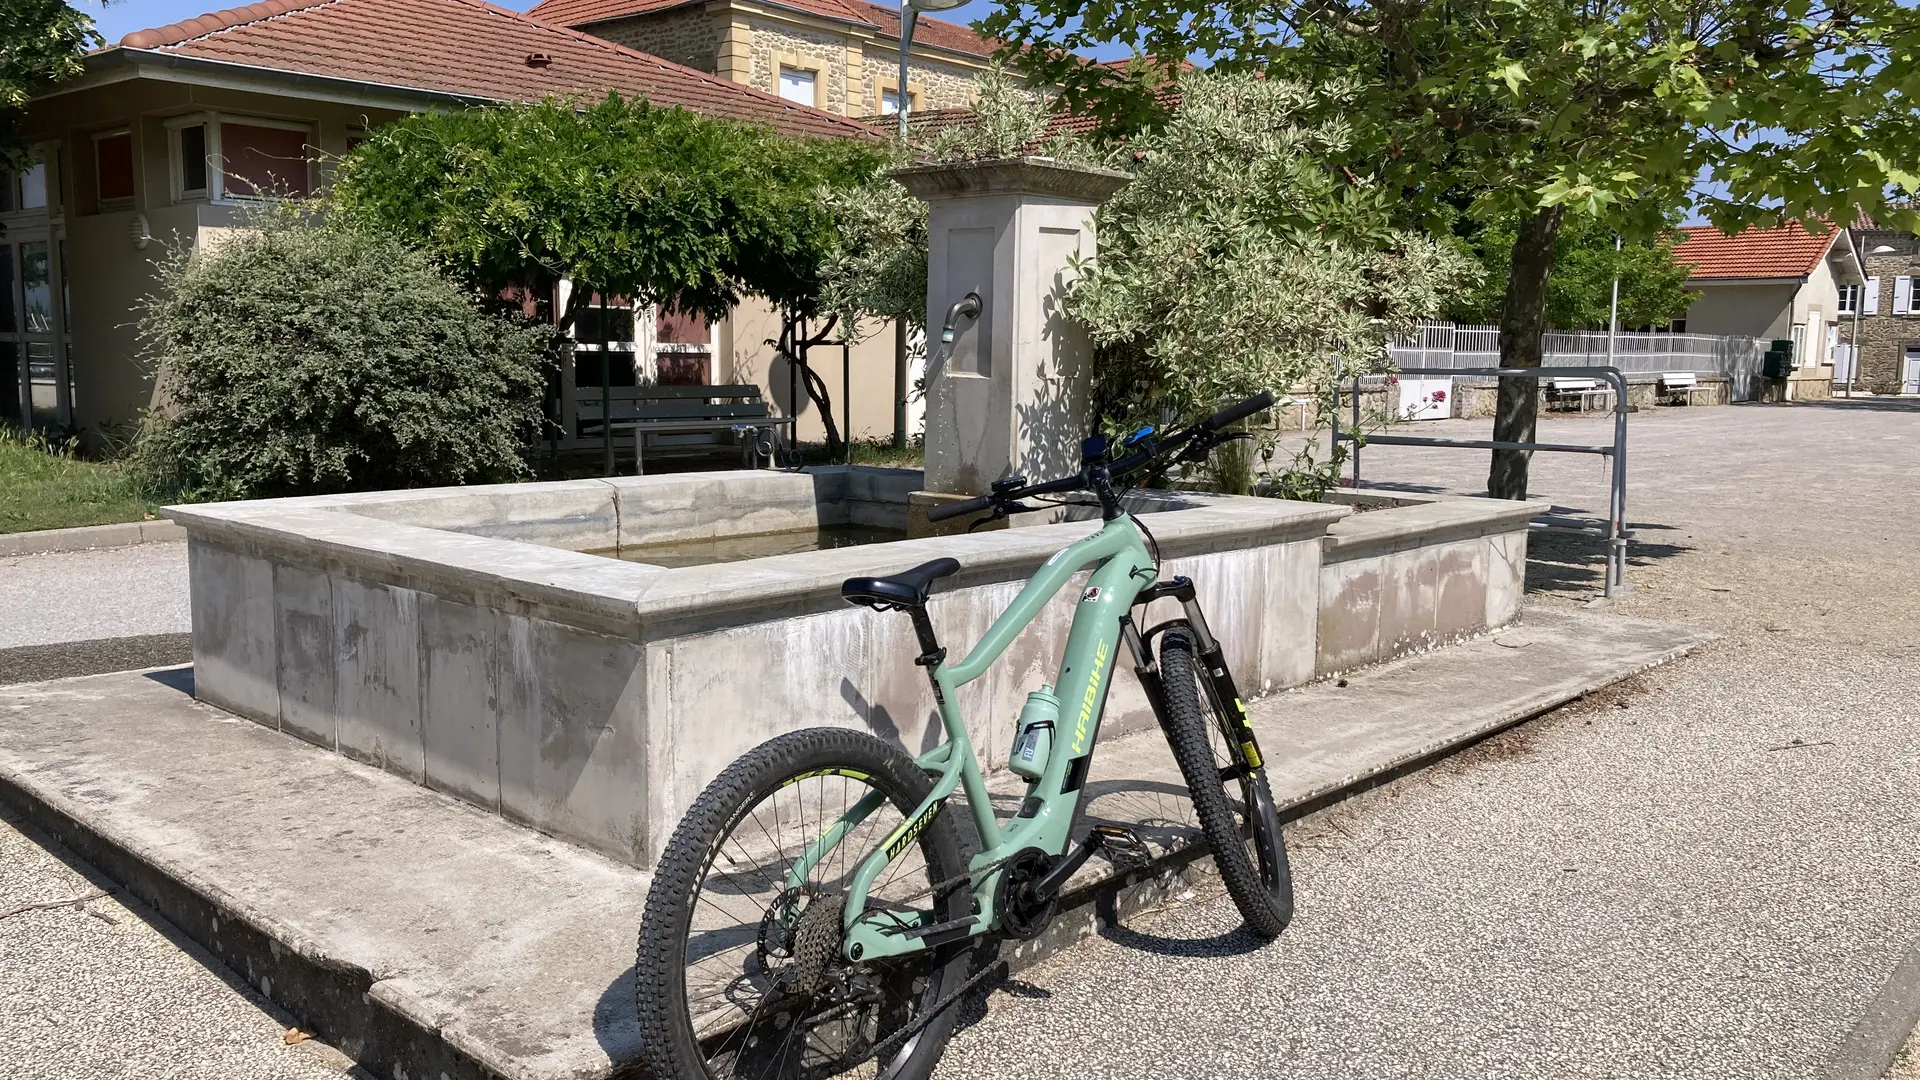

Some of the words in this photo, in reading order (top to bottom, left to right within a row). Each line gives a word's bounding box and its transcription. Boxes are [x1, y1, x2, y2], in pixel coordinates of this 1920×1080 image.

[1071, 638, 1109, 755] HAIBIKE
[725, 796, 752, 829] RANGER
[889, 800, 938, 861] HARDSEVEN
